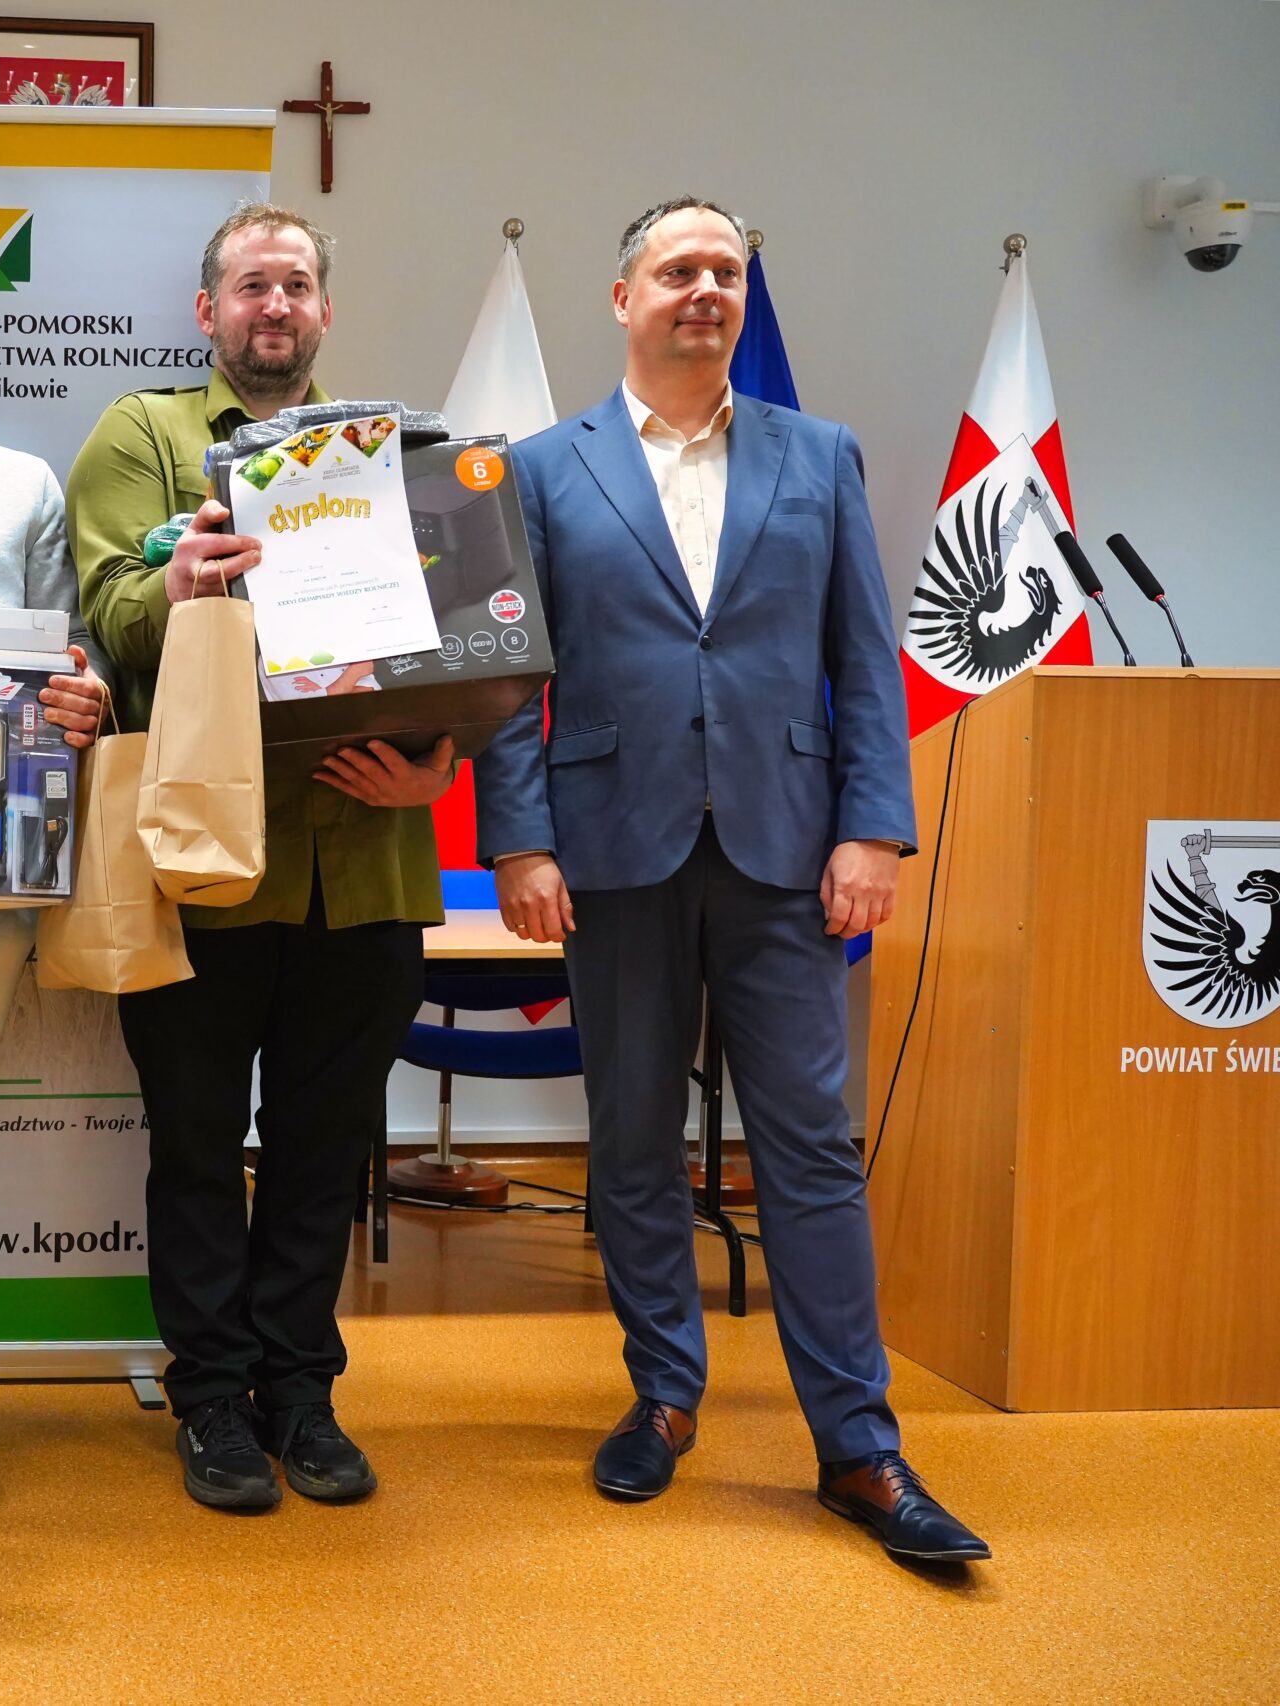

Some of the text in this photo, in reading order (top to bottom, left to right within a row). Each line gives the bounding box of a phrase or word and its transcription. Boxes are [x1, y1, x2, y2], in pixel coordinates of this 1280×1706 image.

[472, 462, 487, 479] 6
[269, 492, 371, 533] dyplom
[511, 636, 519, 645] 8
[1120, 1046, 1218, 1073] POWIAT
[84, 1114, 135, 1133] Twoje
